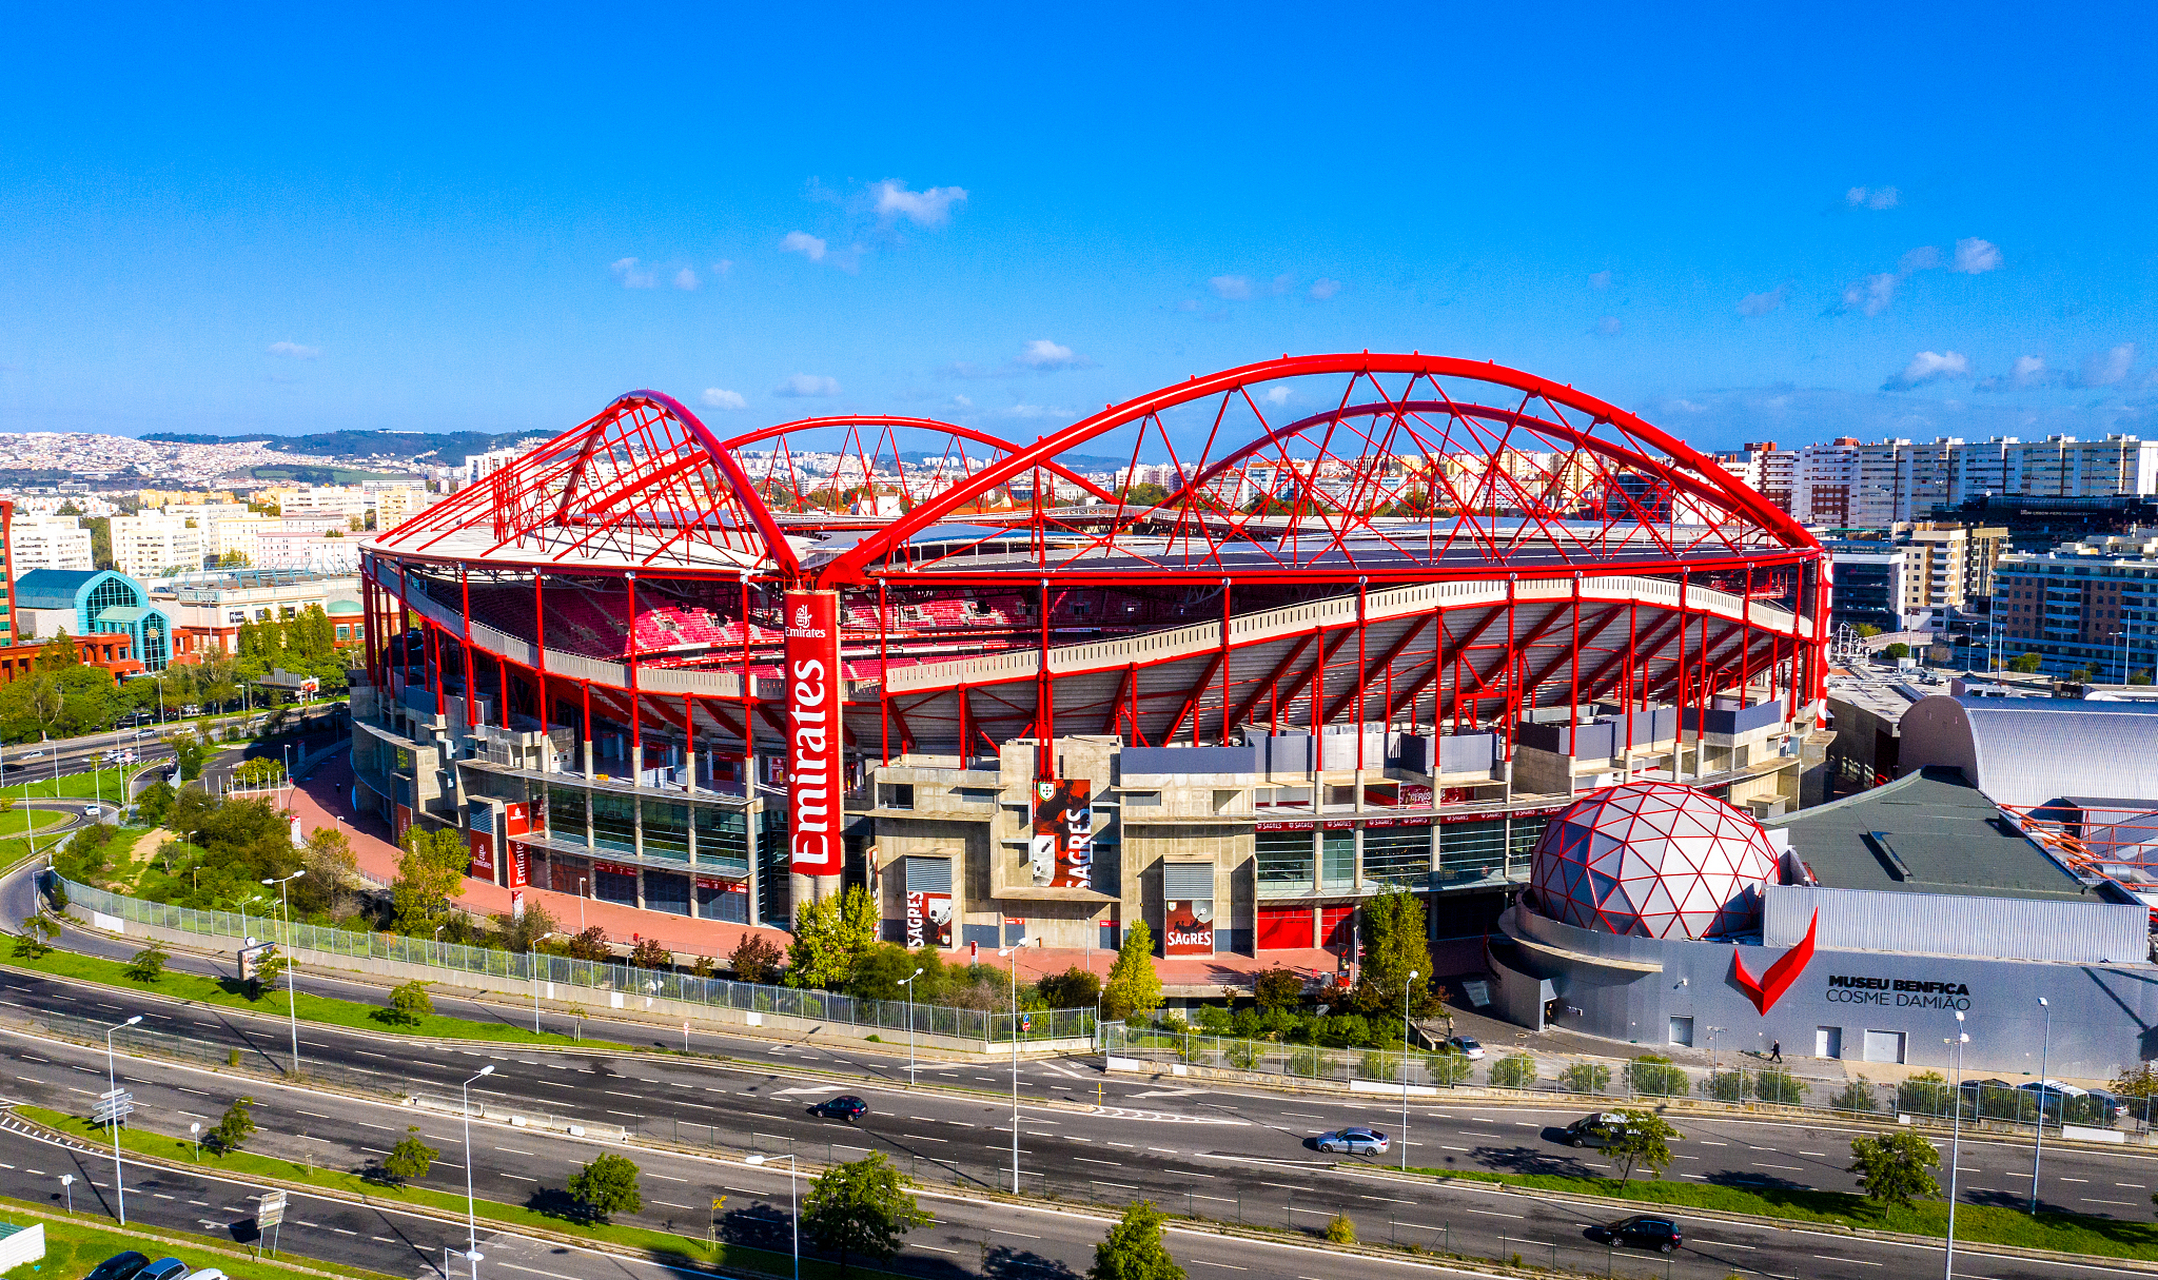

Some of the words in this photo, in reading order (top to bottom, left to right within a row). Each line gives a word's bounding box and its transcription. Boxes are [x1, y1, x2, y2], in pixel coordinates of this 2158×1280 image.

[785, 626, 826, 638] Emirates
[790, 659, 829, 864] Emirates
[907, 891, 925, 947] SAGRES
[1167, 931, 1212, 946] SAGRES
[1829, 975, 1890, 990] MUSEU
[1893, 979, 1970, 996] BENFICA
[1826, 988, 1891, 1006] COSME
[1896, 994, 1971, 1011] DAMIÃO
